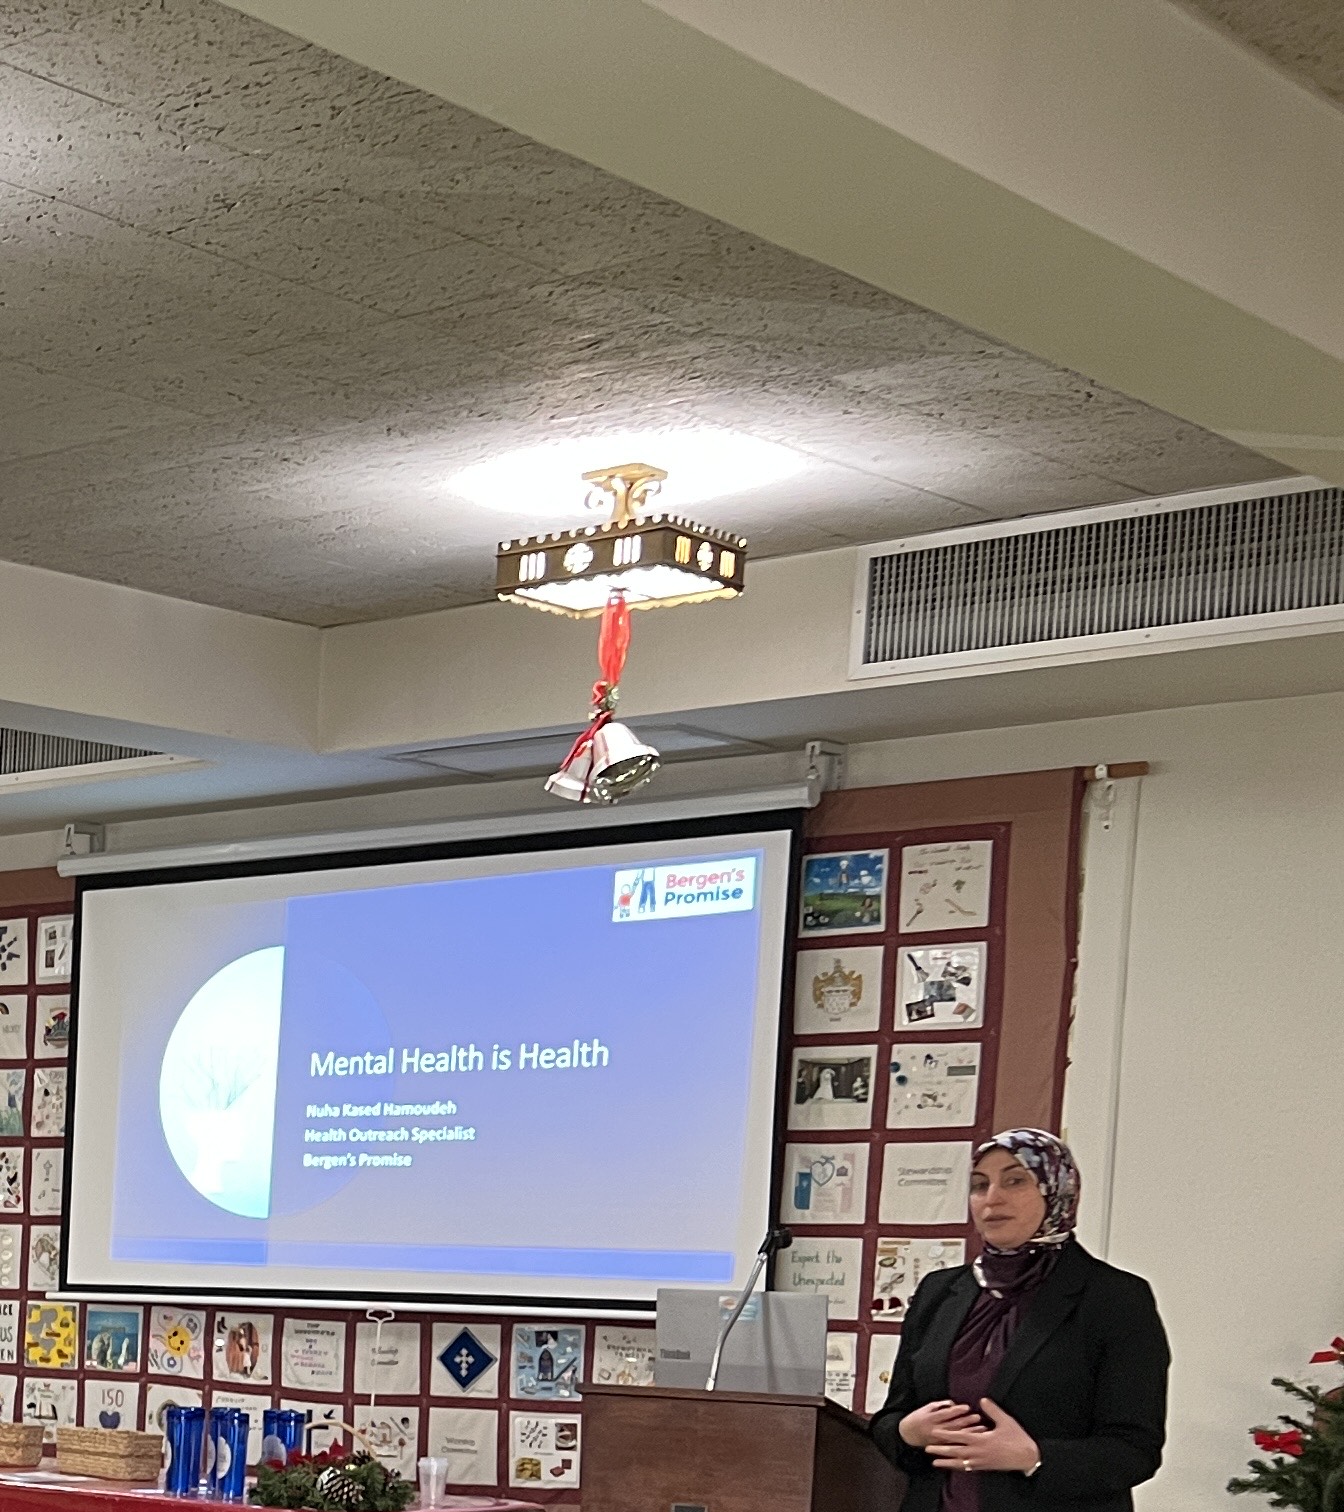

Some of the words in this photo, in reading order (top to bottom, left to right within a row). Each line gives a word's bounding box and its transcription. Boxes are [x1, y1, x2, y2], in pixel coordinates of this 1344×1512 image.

[665, 867, 745, 890] Bergen's
[664, 885, 744, 906] Promise
[310, 1047, 394, 1077] Mental
[401, 1044, 484, 1073] Health
[491, 1043, 512, 1071] is
[519, 1038, 610, 1070] Health
[304, 1128, 346, 1142] Health
[348, 1127, 410, 1142] Outreach
[411, 1126, 476, 1144] Specialist
[303, 1152, 357, 1170] Bergen's
[358, 1152, 413, 1167] Promise
